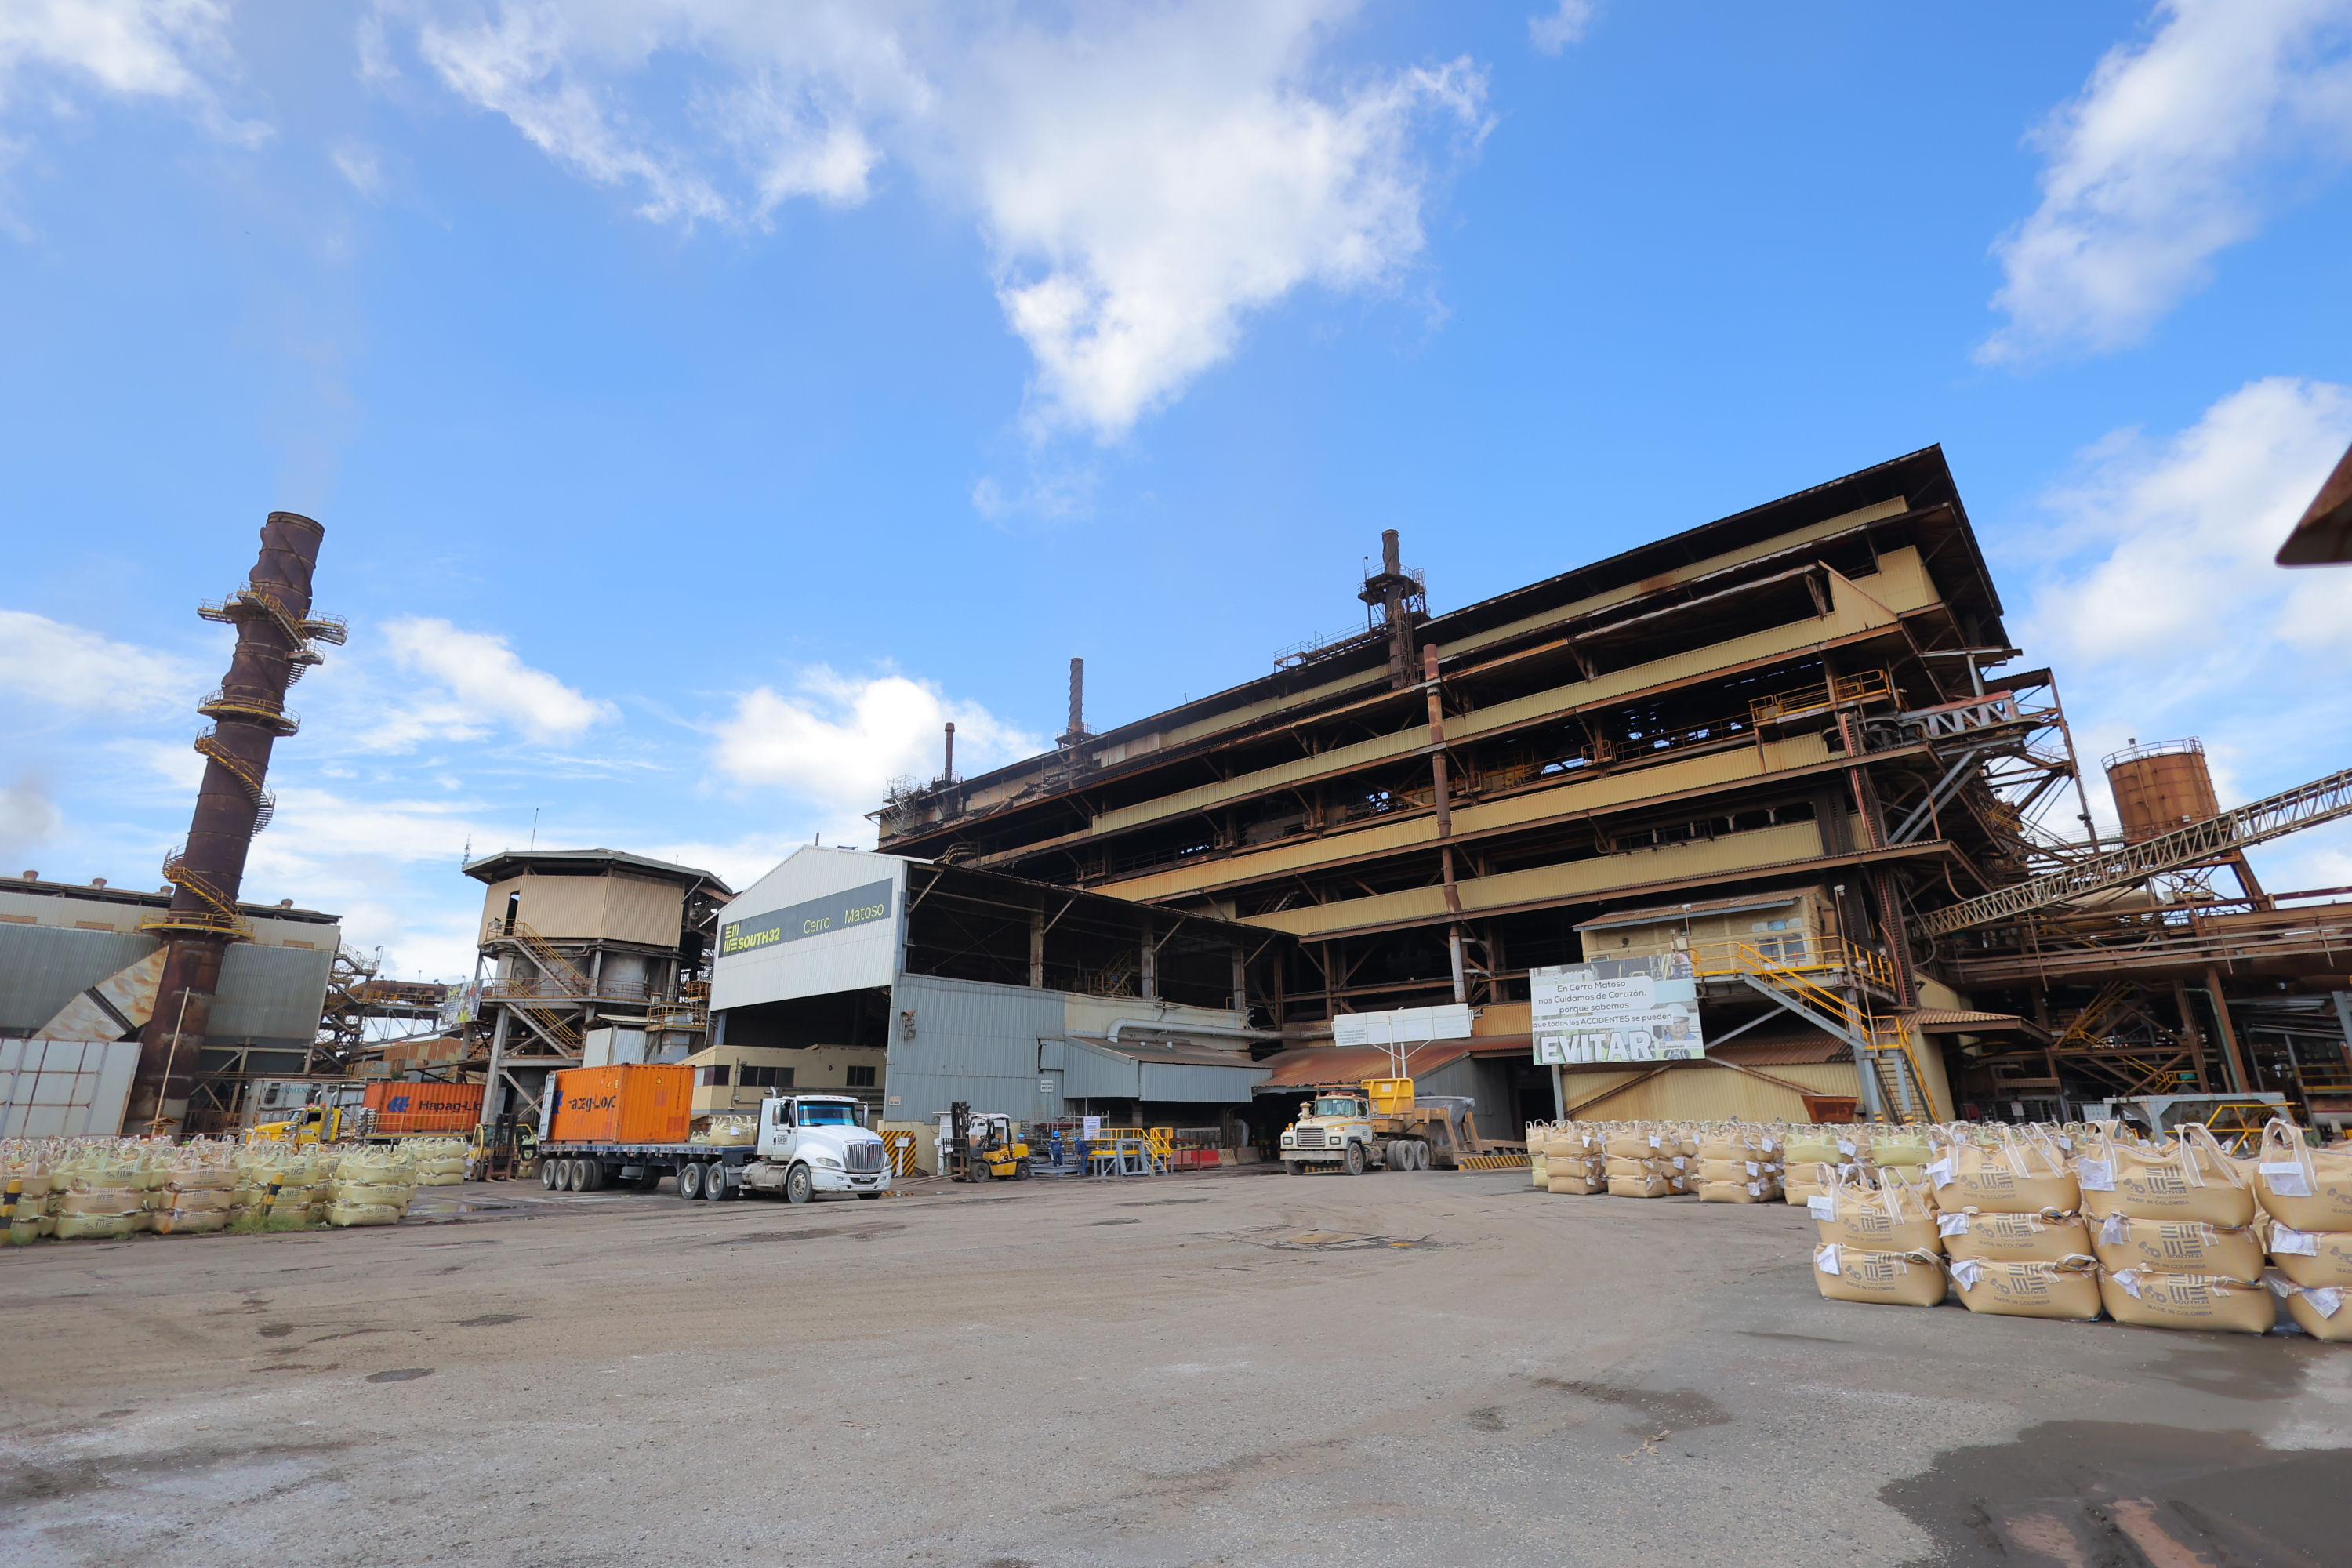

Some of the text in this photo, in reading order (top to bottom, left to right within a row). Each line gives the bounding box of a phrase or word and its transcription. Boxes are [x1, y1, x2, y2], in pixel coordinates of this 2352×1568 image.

[738, 904, 884, 949] SOUTH32 Cerro Matoso
[1555, 995, 1595, 1004] Cuidamos
[1559, 1003, 1629, 1015] porque sabemos
[1581, 1015, 1630, 1025] ACCIDENTES
[1642, 1014, 1672, 1022] pueden
[1541, 1031, 1655, 1064] EVITAR
[2147, 1305, 2165, 1313] MADE
